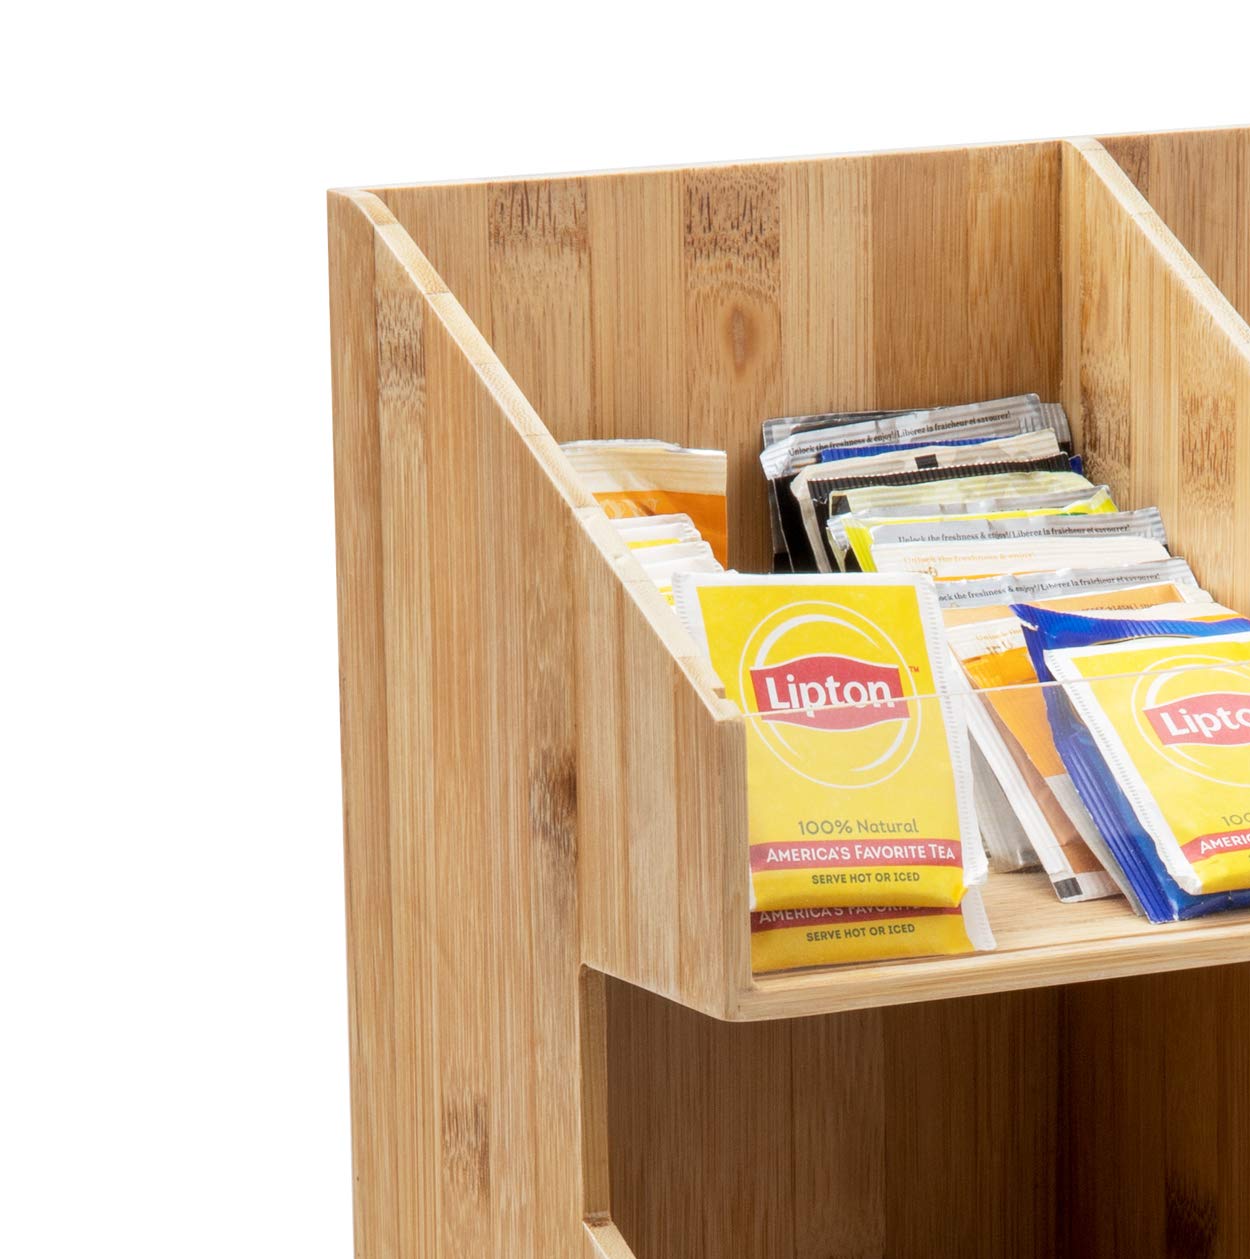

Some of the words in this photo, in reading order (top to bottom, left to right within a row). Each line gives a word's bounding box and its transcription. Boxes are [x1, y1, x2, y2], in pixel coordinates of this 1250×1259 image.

[765, 673, 895, 719] Lipton
[798, 819, 853, 837] 100%
[857, 818, 919, 834] Natural
[766, 846, 851, 864] AMERICA'S
[854, 844, 926, 861] FAVORITE
[928, 844, 955, 860] TEA
[811, 873, 847, 885] SERVE
[849, 872, 873, 884] HOT
[875, 872, 891, 883] OR
[893, 871, 920, 882] ICED
[807, 929, 842, 942] SERVE
[844, 927, 869, 940] HOT
[869, 926, 886, 938] OR
[887, 923, 916, 936] ICED
